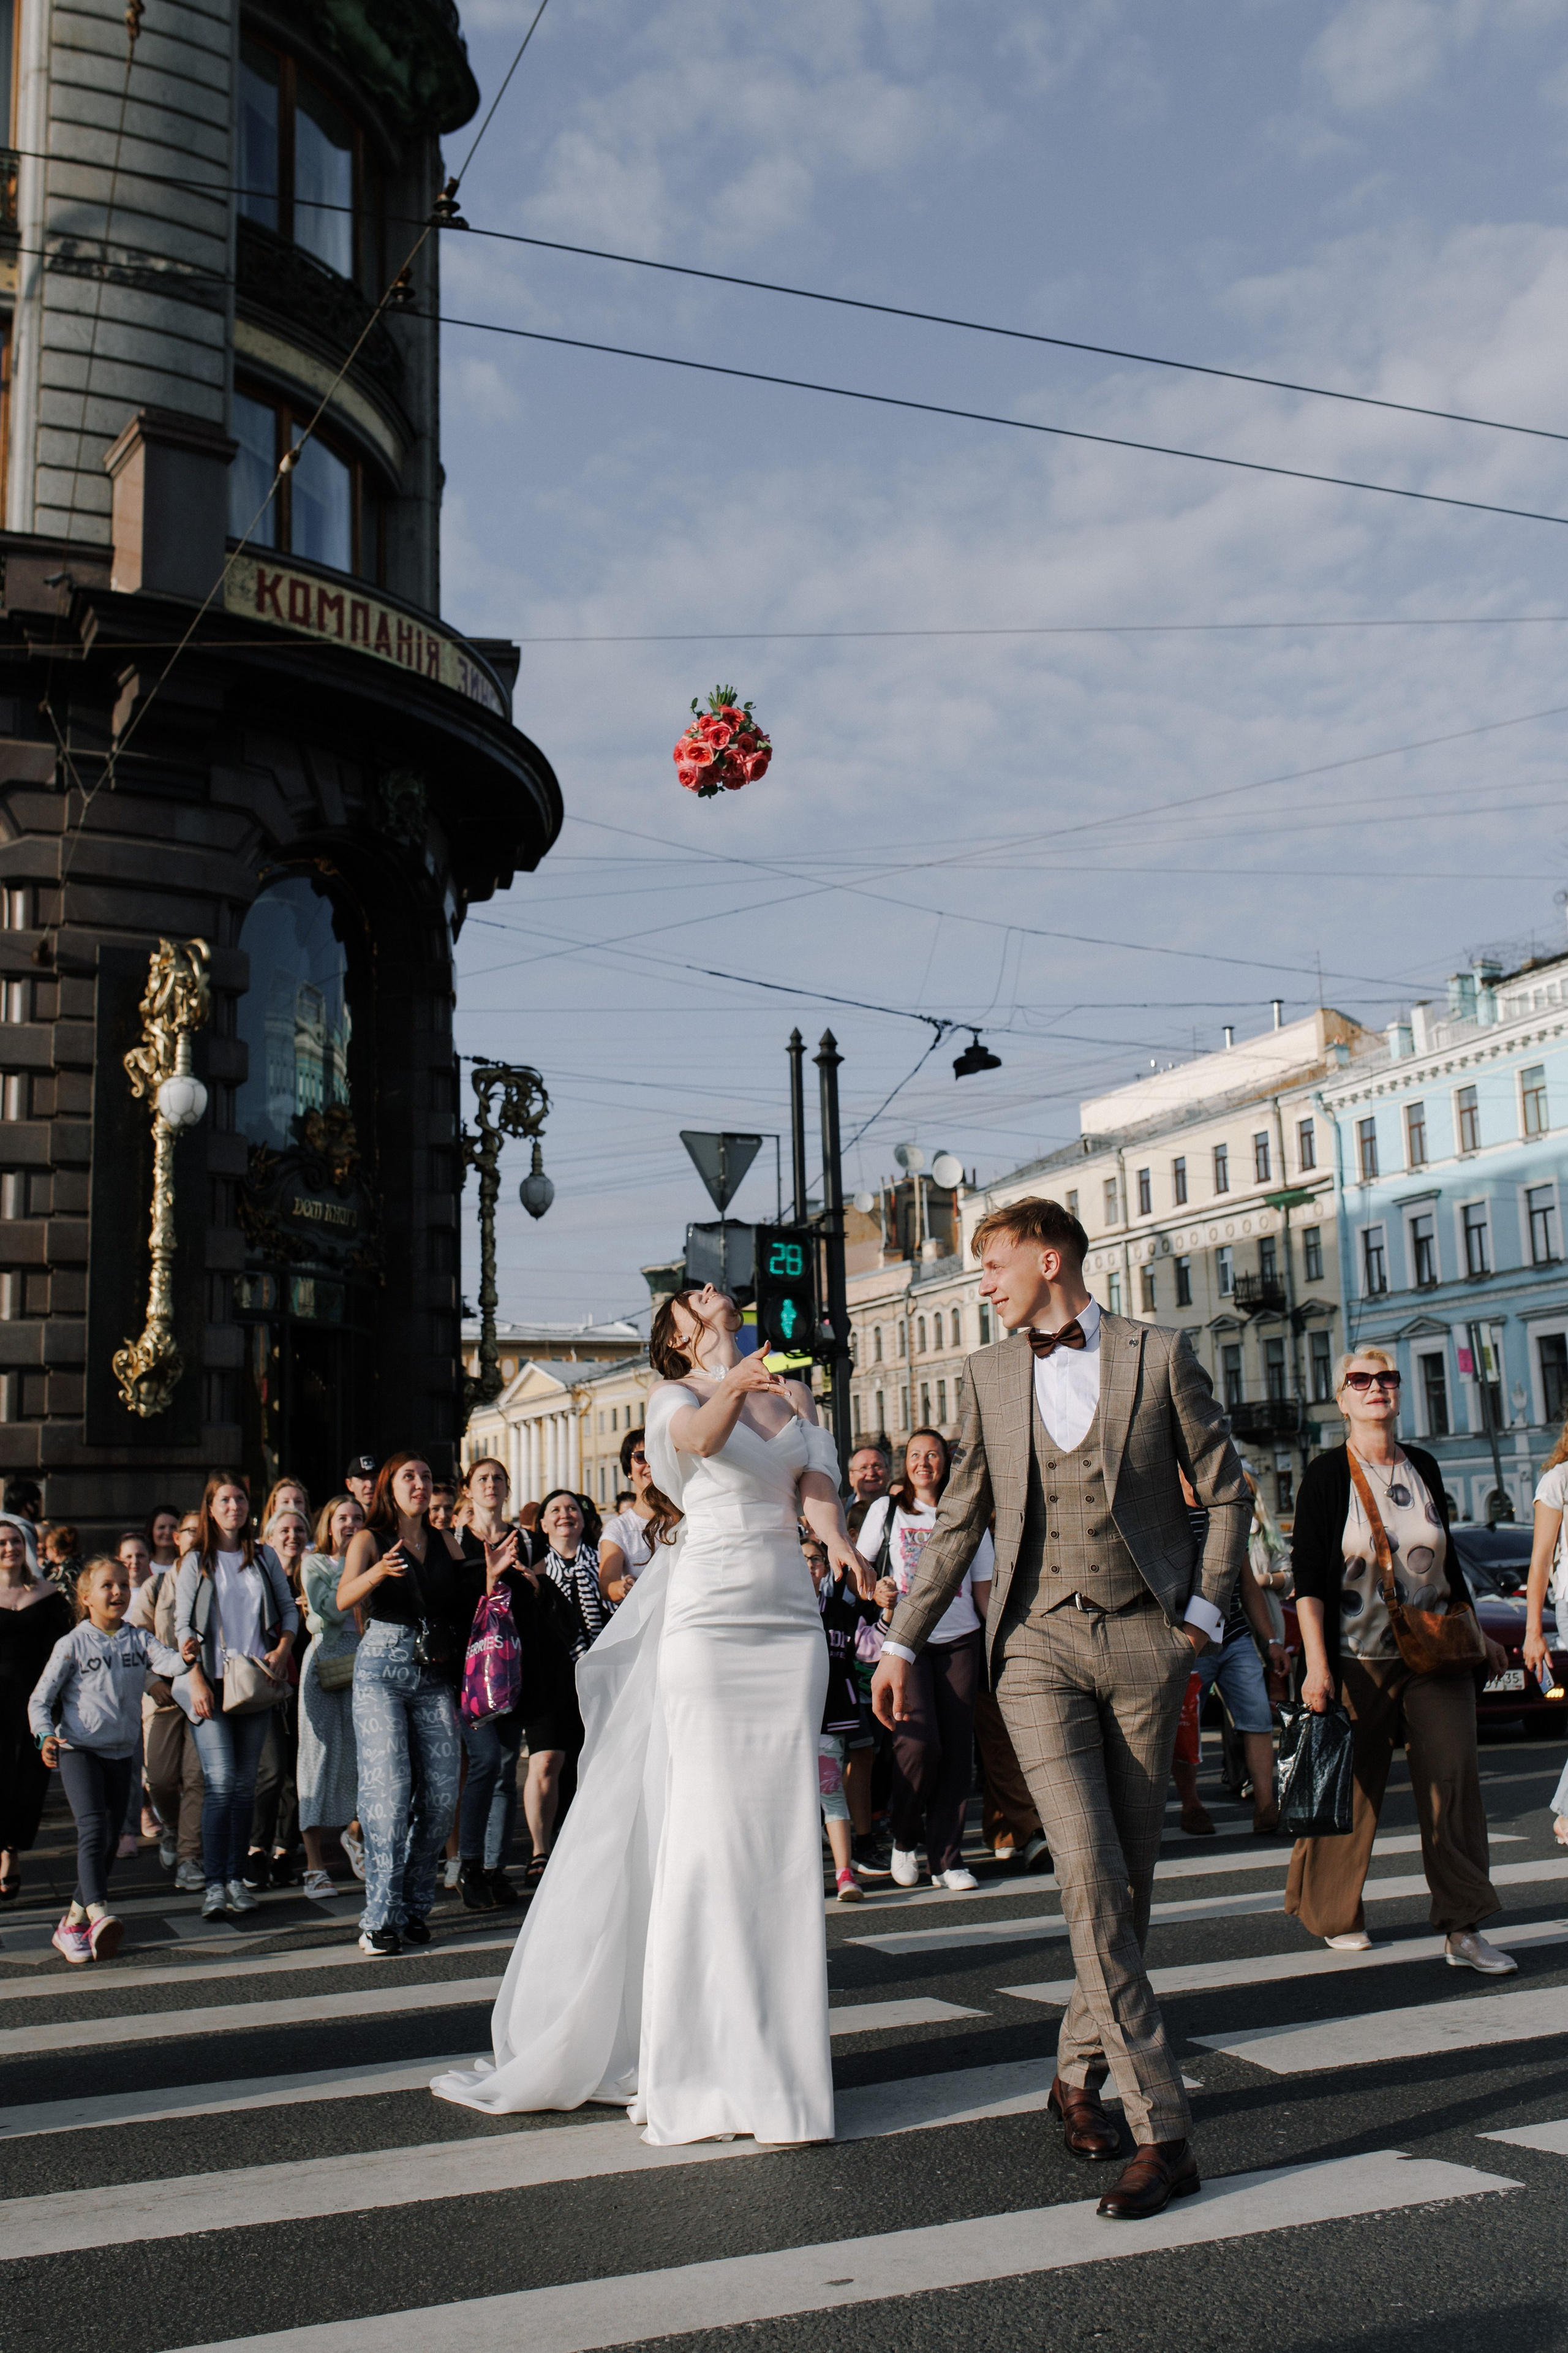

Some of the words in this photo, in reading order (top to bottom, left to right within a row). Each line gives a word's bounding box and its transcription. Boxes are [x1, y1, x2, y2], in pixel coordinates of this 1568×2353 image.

[257, 568, 440, 681] КОМПАНІЯ
[769, 1242, 802, 1275] 28
[382, 1665, 410, 1682] NO
